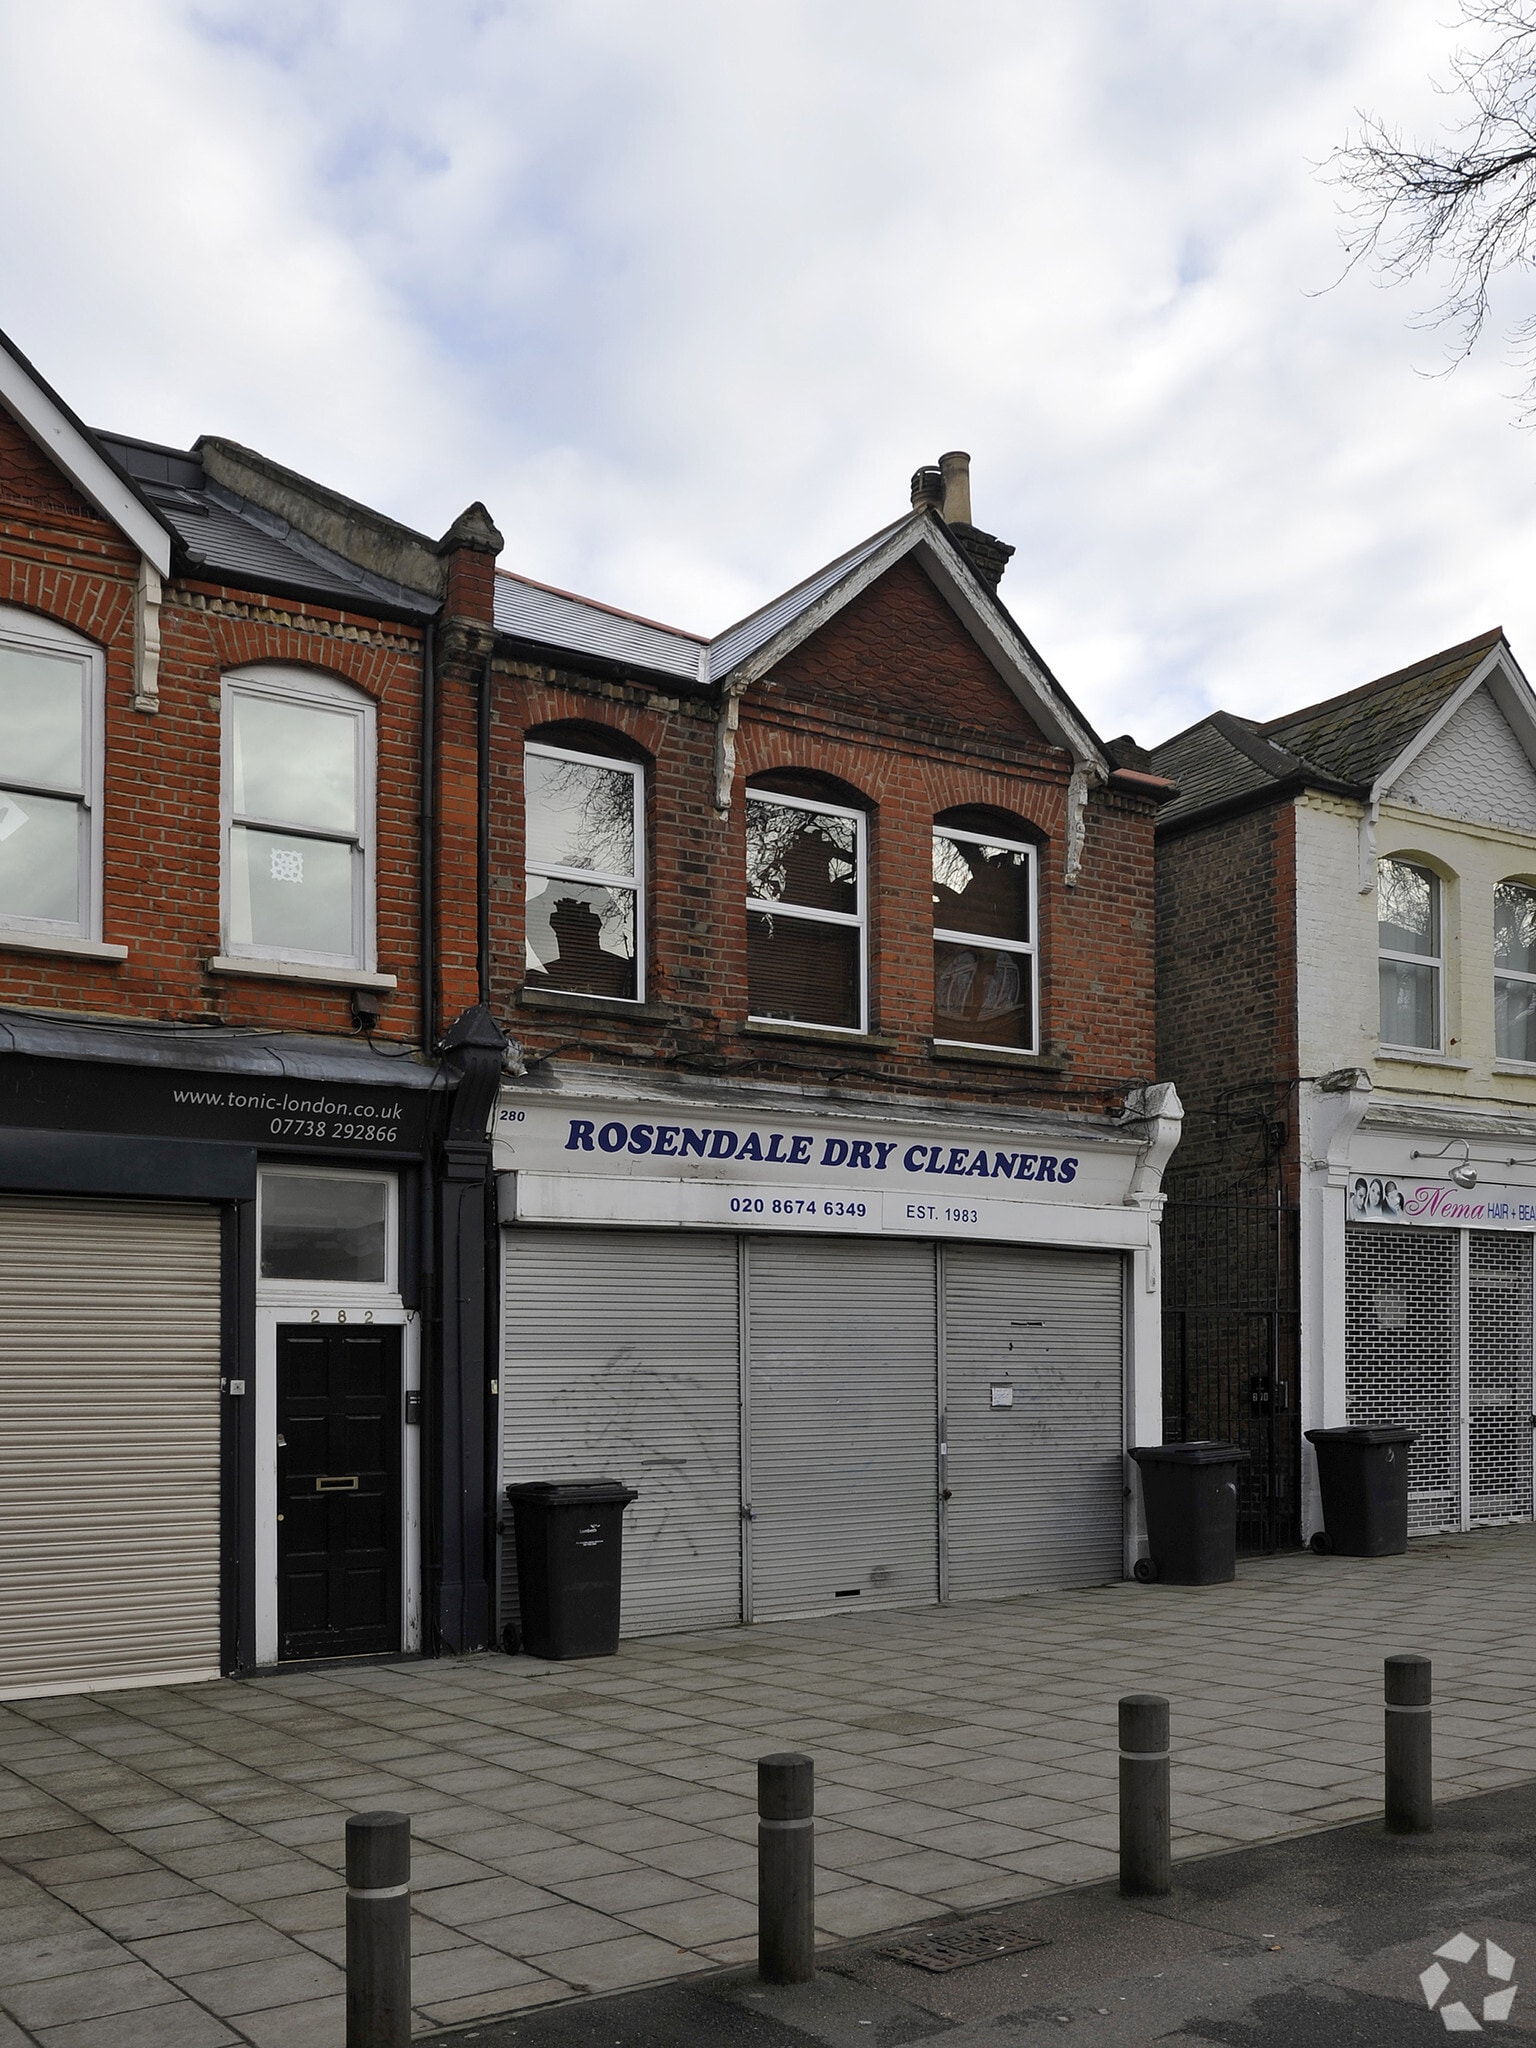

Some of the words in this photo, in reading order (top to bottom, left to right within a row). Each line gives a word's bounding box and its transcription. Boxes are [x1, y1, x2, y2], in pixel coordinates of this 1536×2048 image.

[173, 1090, 403, 1120] www.tonic-london.co.uk
[500, 1110, 525, 1122] 280
[270, 1118, 326, 1137] 07738
[332, 1122, 397, 1142] 292866
[564, 1119, 814, 1165] ROSENDALE
[820, 1137, 897, 1170] DRY
[903, 1144, 1079, 1183] CLEANERS
[730, 1198, 764, 1213] 020
[771, 1200, 817, 1215] 8674
[823, 1202, 866, 1217] 6349
[906, 1205, 938, 1220] EST.
[944, 1207, 978, 1223] 1983
[1404, 1187, 1485, 1220] Nema
[1487, 1202, 1509, 1220] HAIR
[310, 1309, 374, 1325] 282
